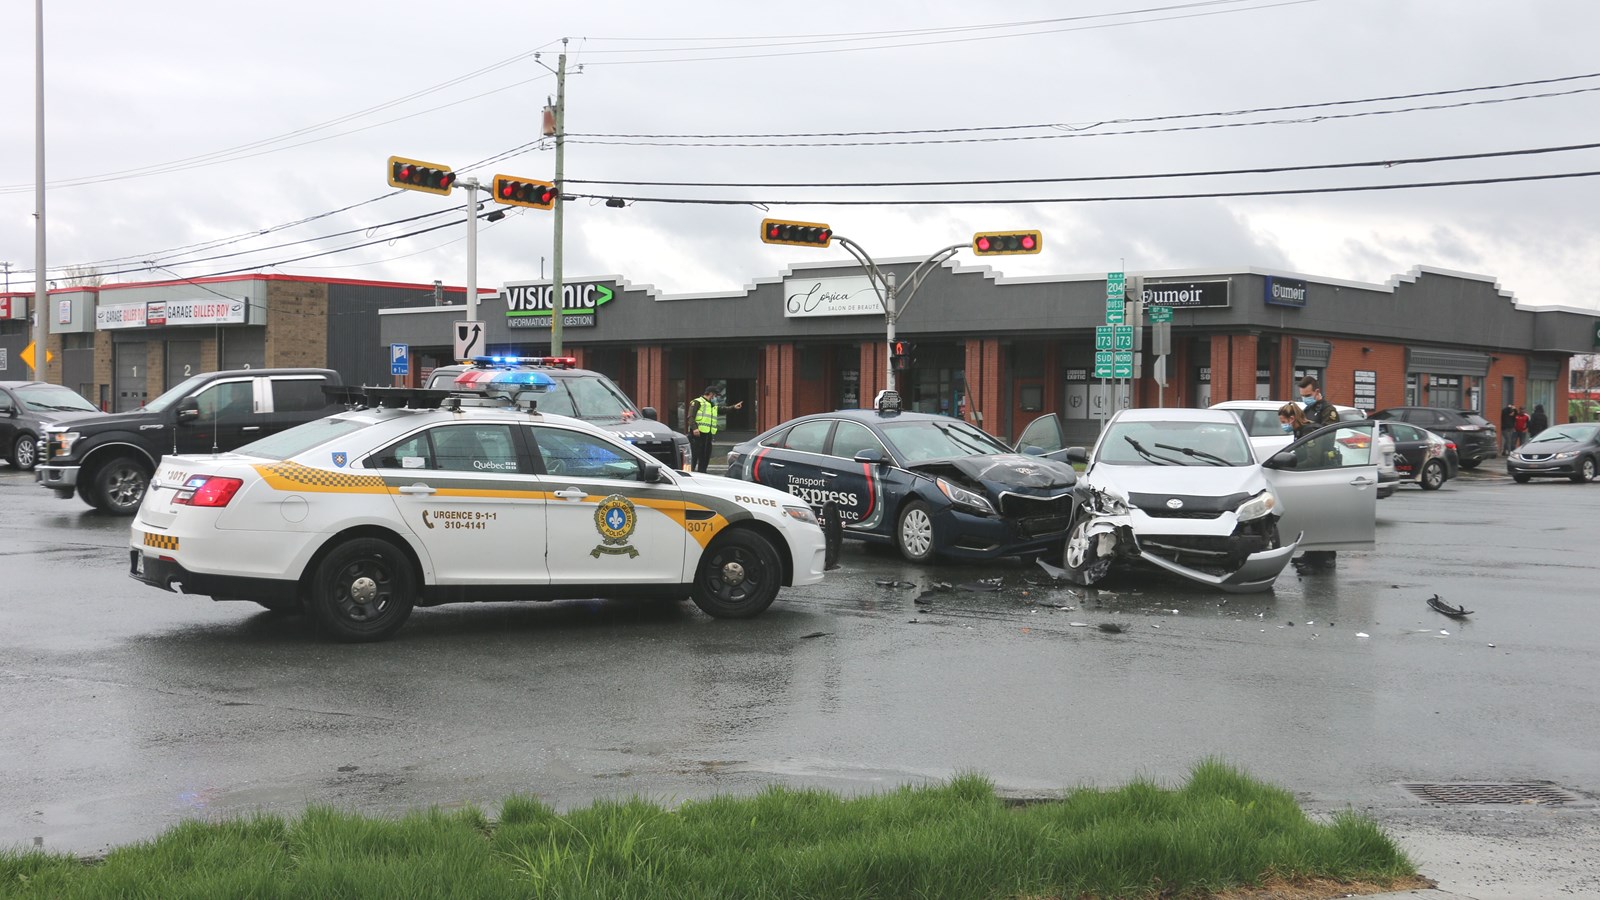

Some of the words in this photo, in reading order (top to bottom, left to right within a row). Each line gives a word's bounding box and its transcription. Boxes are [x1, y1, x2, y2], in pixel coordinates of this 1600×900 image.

[1108, 282, 1122, 292] 204
[1108, 300, 1122, 308] OUEST
[106, 310, 122, 322] GARAGE
[168, 305, 192, 318] GARAGE
[194, 304, 215, 318] GILLES
[216, 304, 230, 316] ROY
[508, 318, 553, 327] INFORMATIQUE
[564, 316, 592, 326] GESTION
[1098, 336, 1111, 346] 173
[1116, 336, 1130, 346] 173
[132, 366, 137, 377] 1
[184, 365, 191, 376] 2
[473, 460, 505, 470] Québec
[788, 475, 825, 487] Transport
[788, 484, 858, 507] Express
[734, 495, 776, 508] POLICE
[434, 511, 472, 519] URGENCE
[445, 521, 486, 529] 310-4141
[687, 523, 714, 532] 3071
